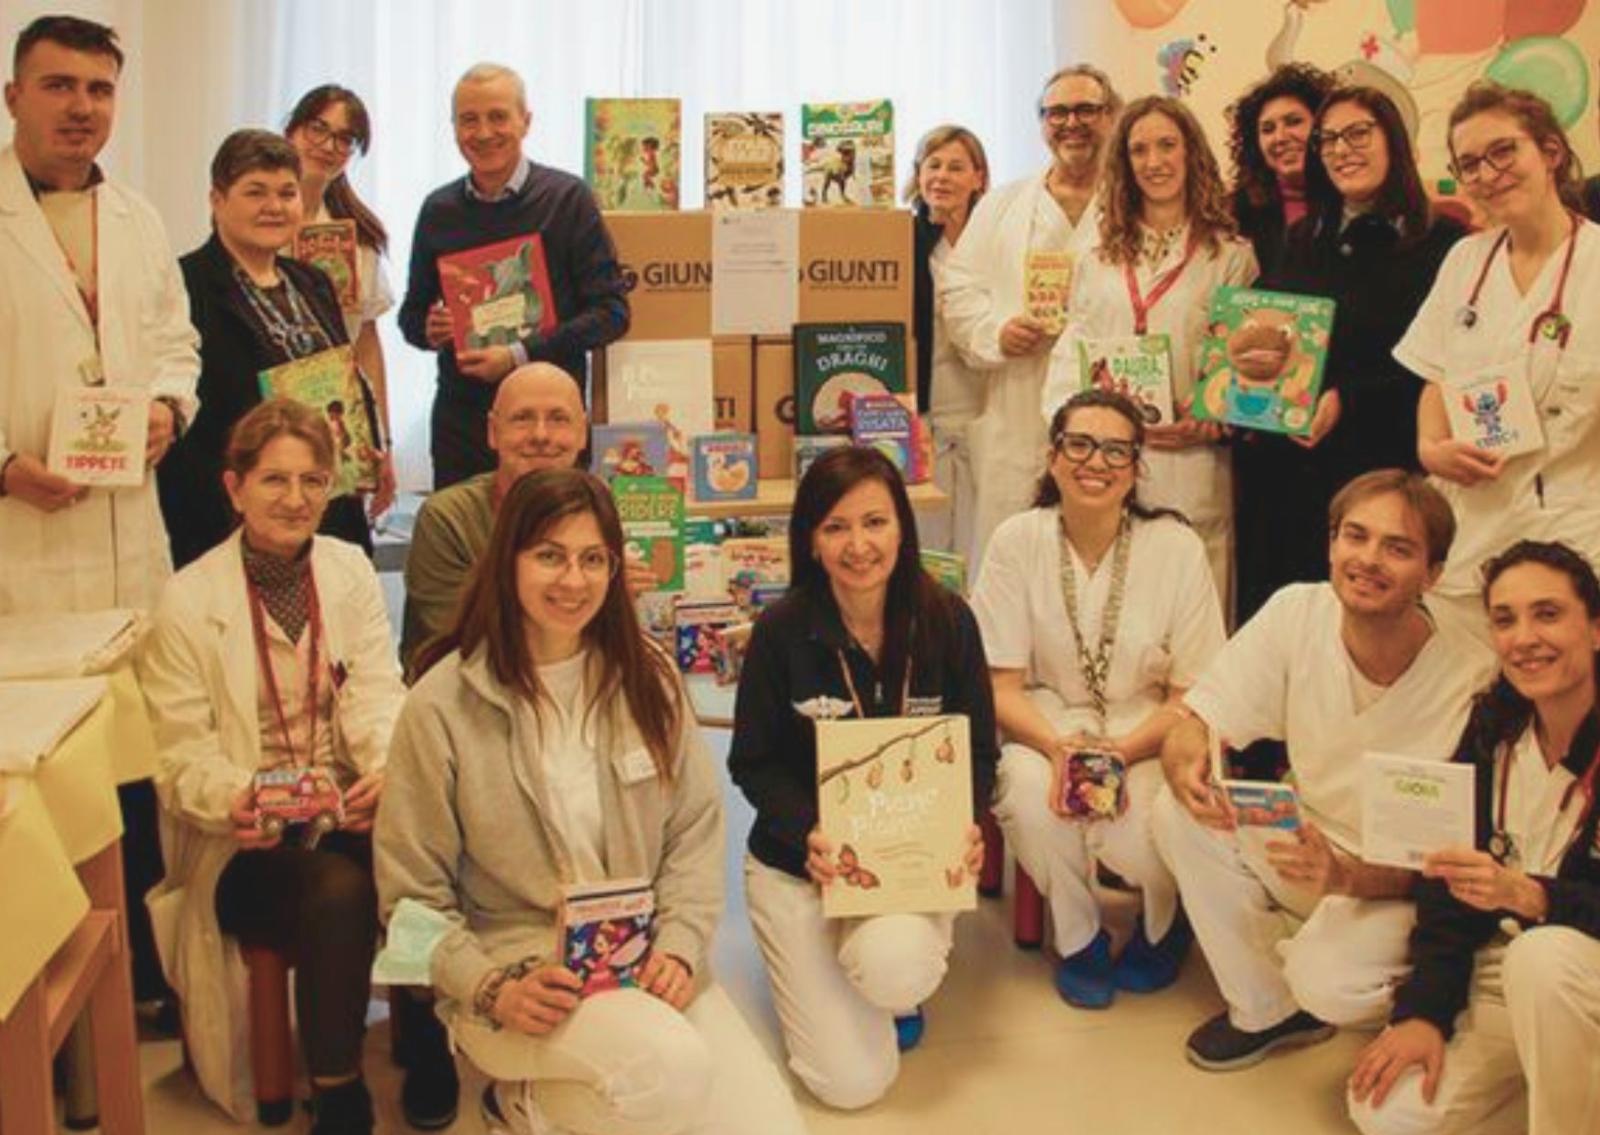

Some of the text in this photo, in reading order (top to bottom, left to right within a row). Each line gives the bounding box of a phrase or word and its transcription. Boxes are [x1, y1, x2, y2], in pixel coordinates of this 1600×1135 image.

[644, 262, 712, 286] GIUN
[809, 260, 898, 284] GIUNTI
[815, 351, 888, 371] DRAGHI
